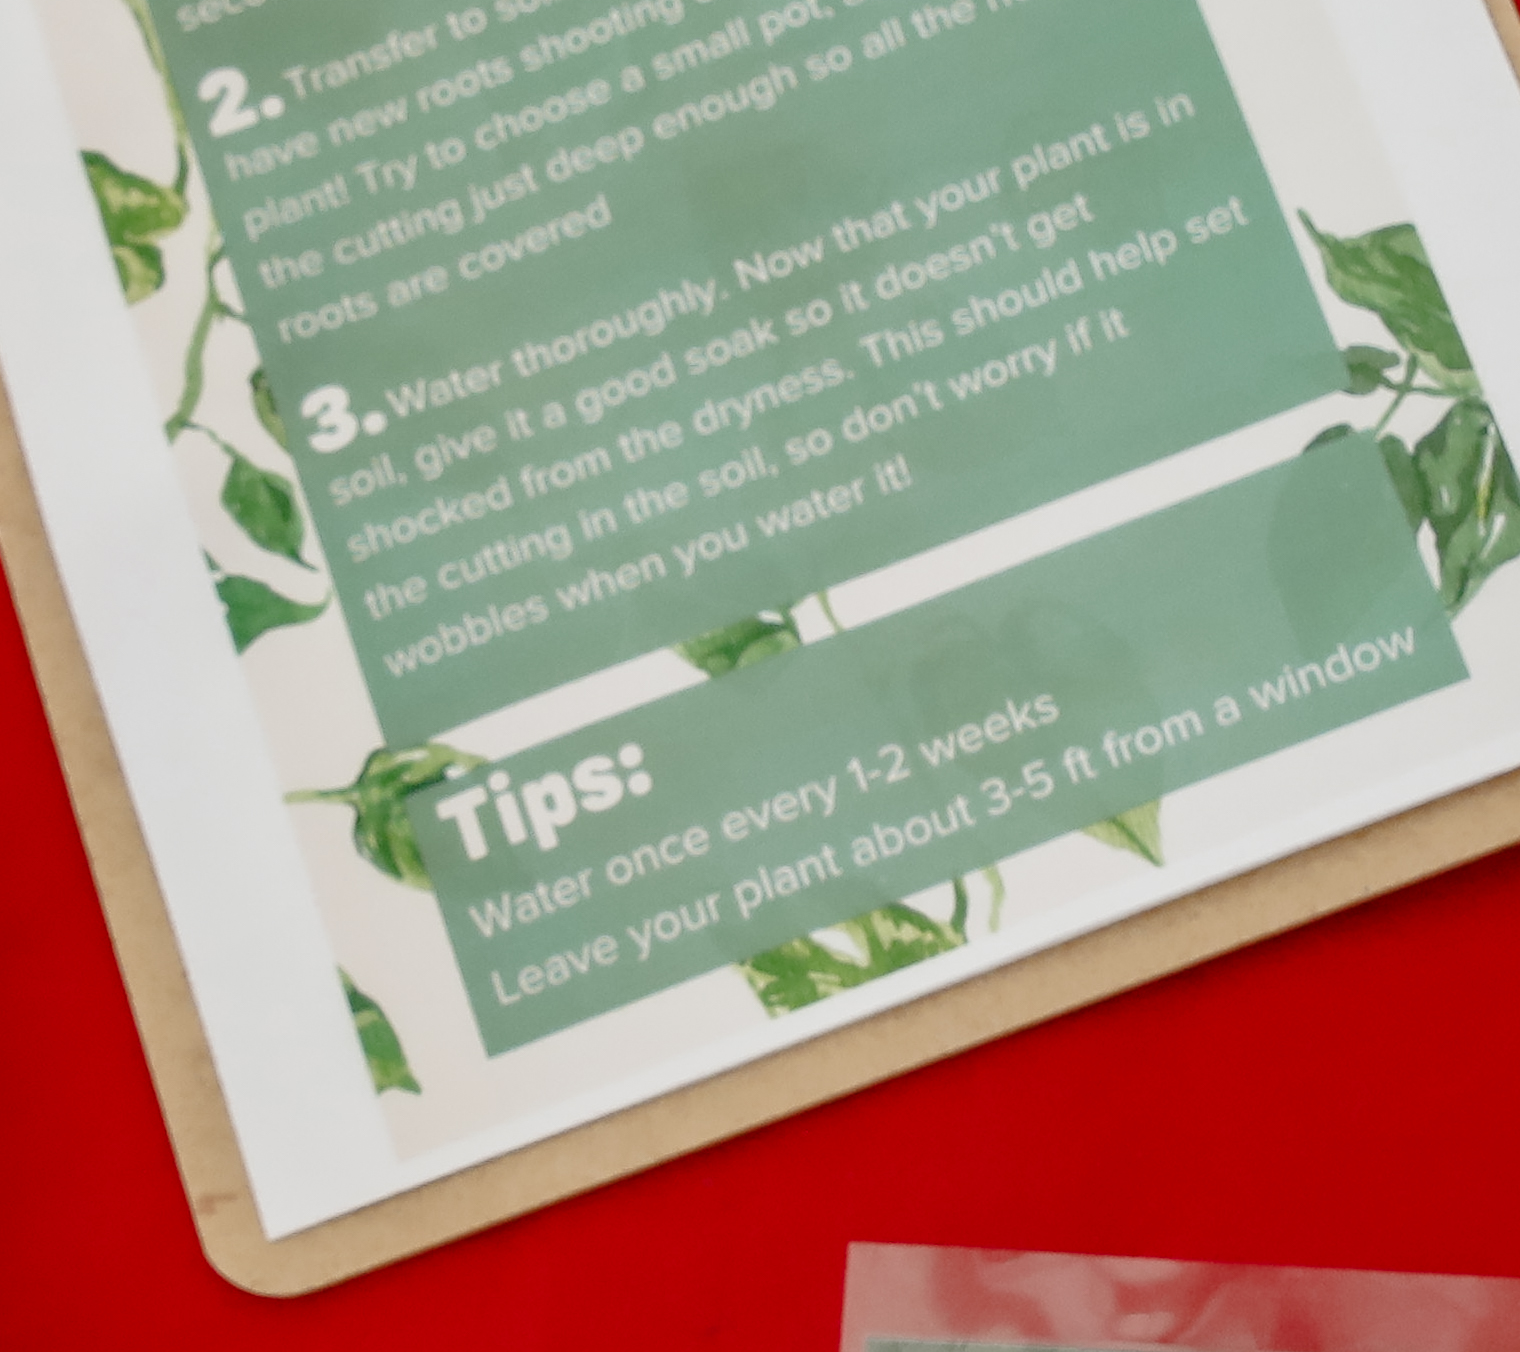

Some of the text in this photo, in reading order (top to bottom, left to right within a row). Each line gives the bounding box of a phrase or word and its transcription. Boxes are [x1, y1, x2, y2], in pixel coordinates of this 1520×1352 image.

[198, 65, 285, 136] 2.
[280, 22, 438, 99] Transfer
[443, 5, 488, 41] to
[275, 191, 613, 343] roots are covered
[299, 91, 1196, 453] 3. Water thoroughly. Now that your plant is in
[382, 452, 914, 678] wobbles when you water it!
[433, 742, 653, 862] Tips:
[466, 692, 1061, 939] Water once every 1-2 weeks
[490, 624, 1416, 1006] Leave your plant about 3-5 ft from a window
